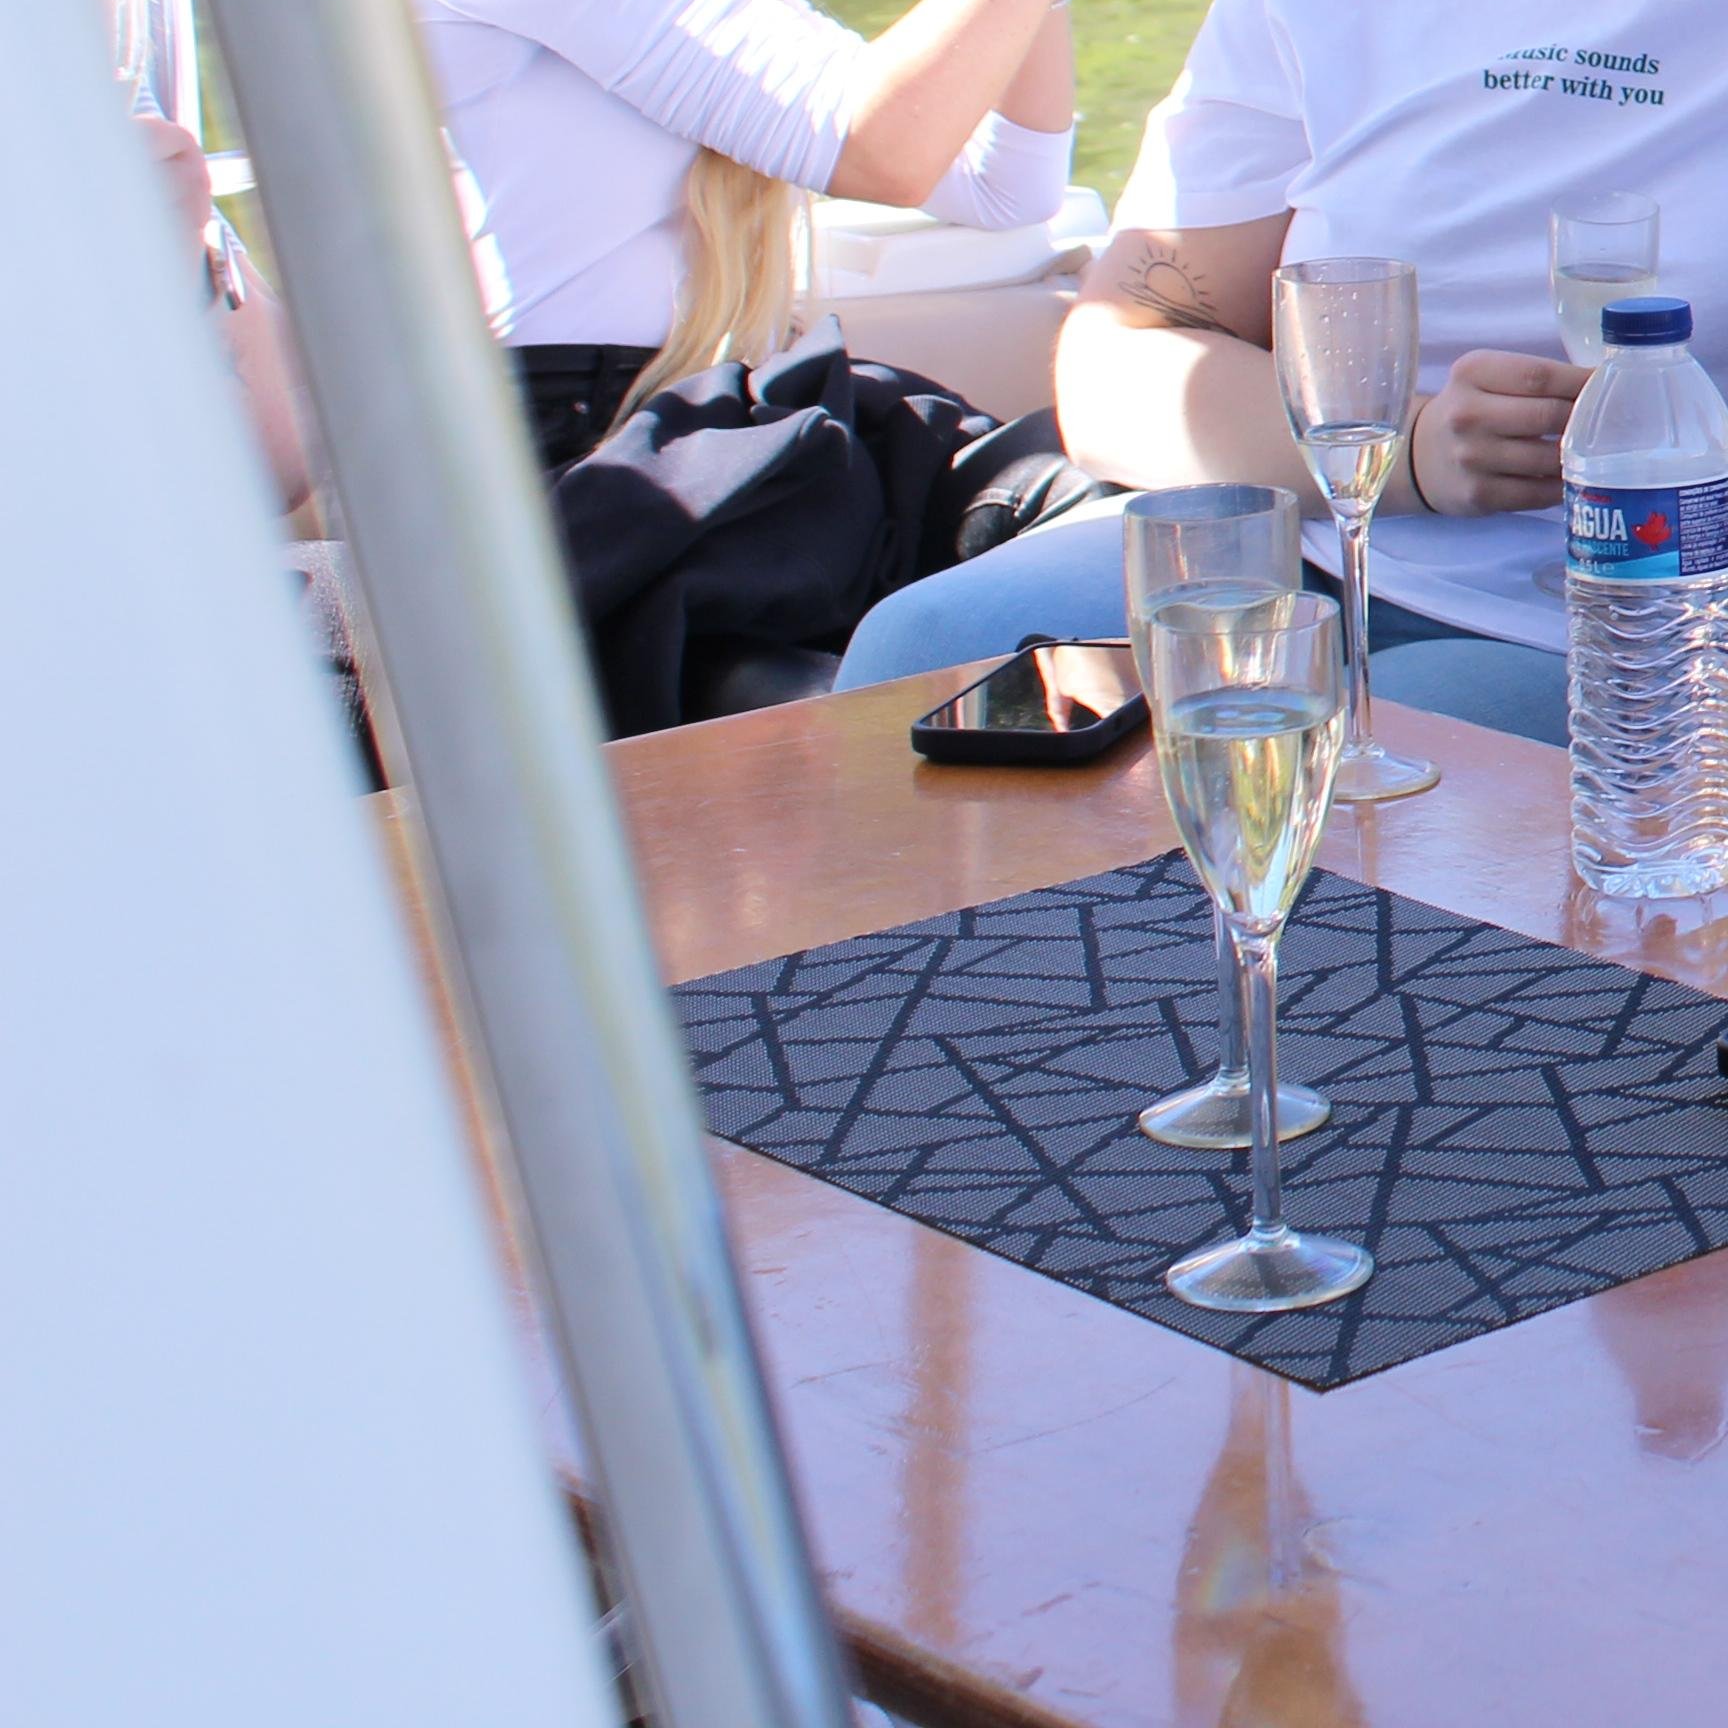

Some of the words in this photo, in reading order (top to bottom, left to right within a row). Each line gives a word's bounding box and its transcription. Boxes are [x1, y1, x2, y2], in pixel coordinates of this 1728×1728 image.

[1574, 48, 1660, 75] sounds
[1482, 69, 1555, 91] better
[1560, 76, 1613, 100] with
[1618, 85, 1665, 106] you
